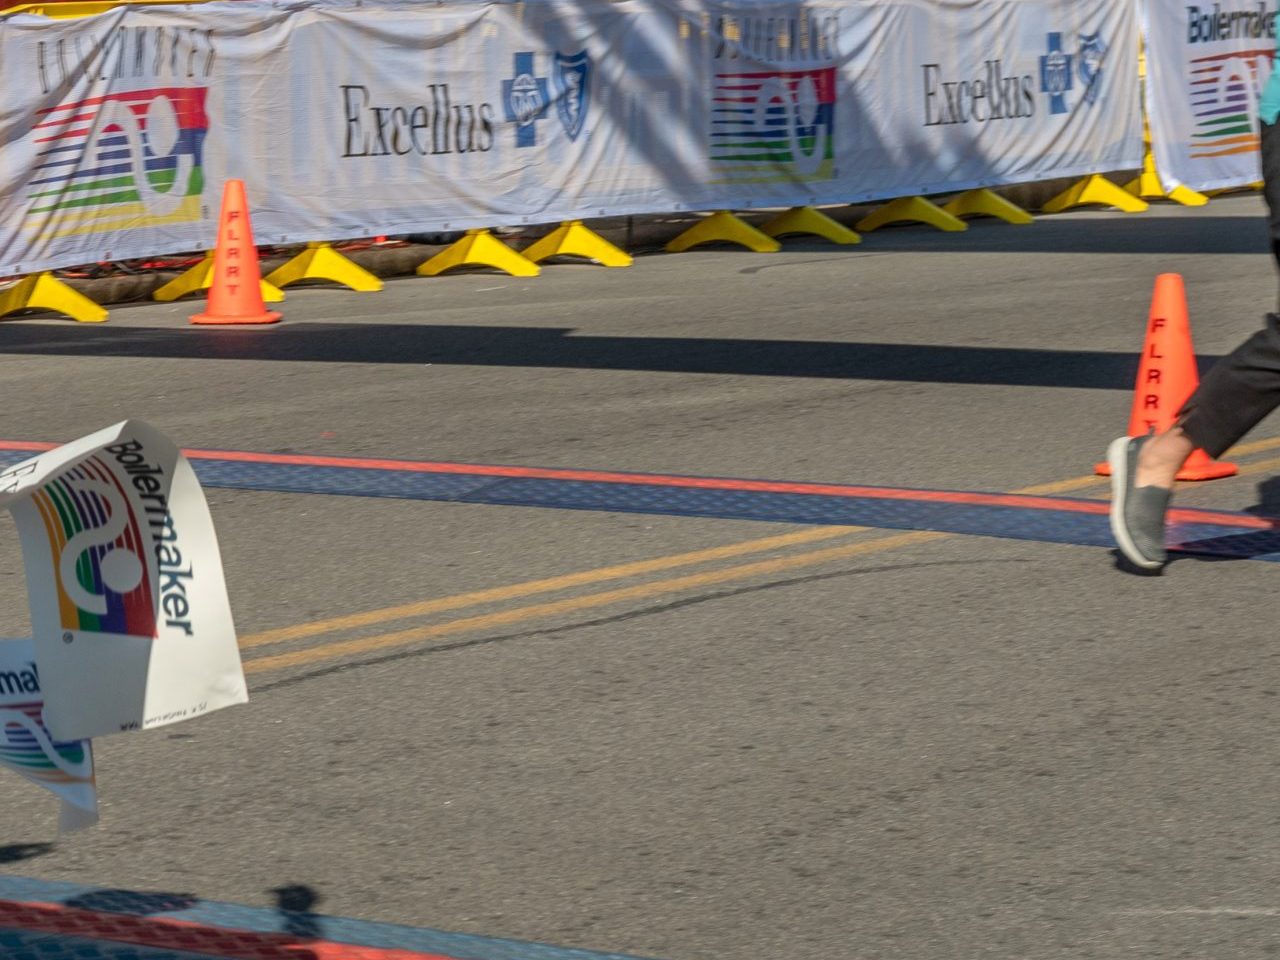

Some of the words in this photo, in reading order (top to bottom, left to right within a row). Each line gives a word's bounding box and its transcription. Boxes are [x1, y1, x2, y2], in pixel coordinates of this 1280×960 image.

[340, 83, 494, 158] Excellus
[921, 60, 1035, 127] Excellus
[105, 438, 194, 638] Boilermaker
